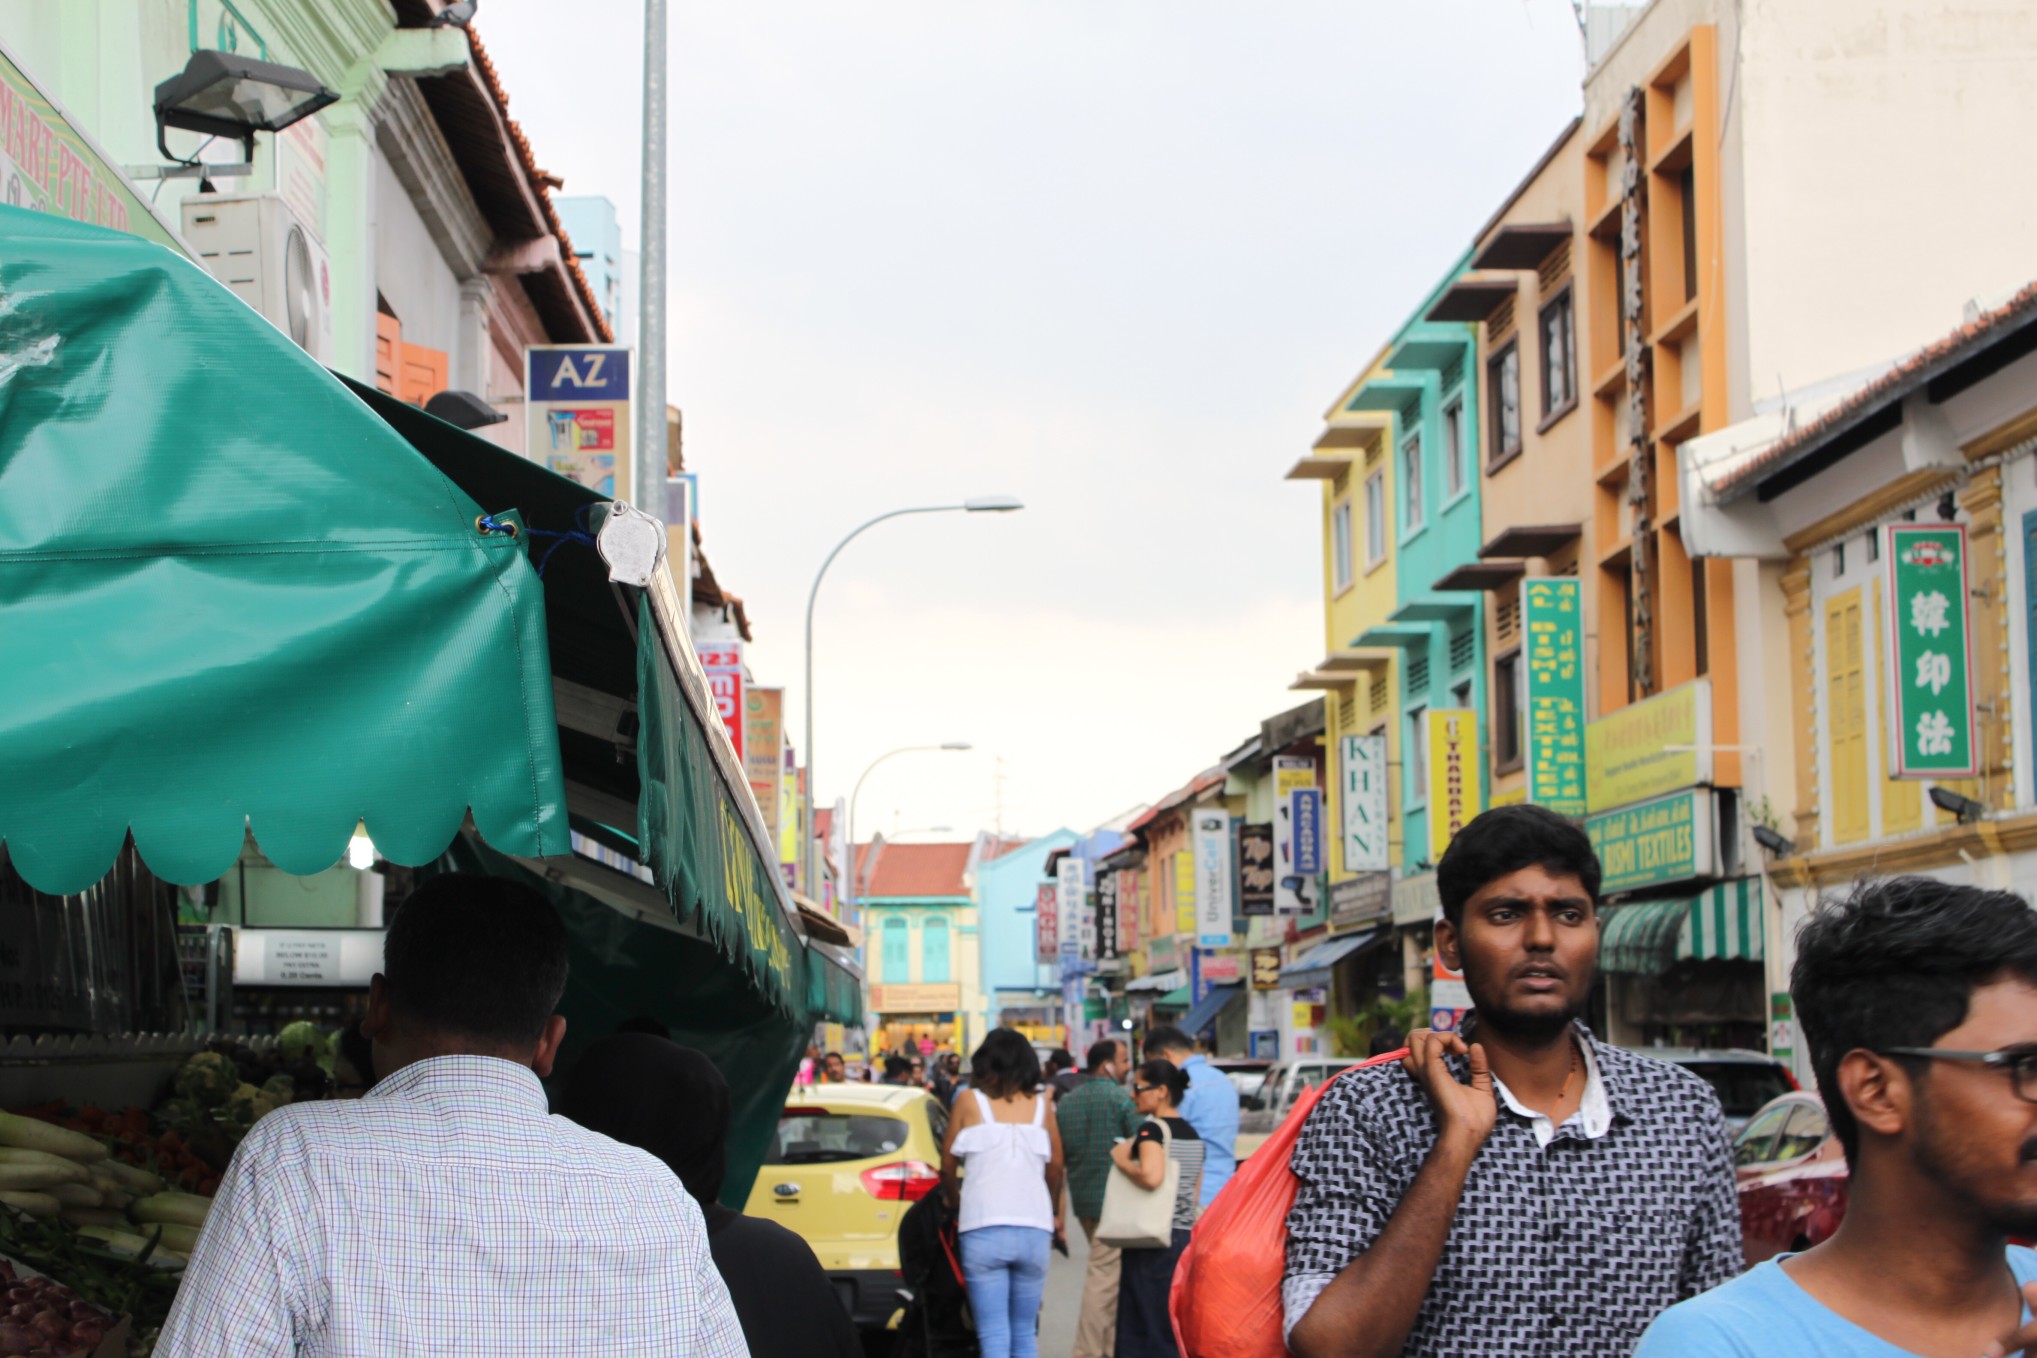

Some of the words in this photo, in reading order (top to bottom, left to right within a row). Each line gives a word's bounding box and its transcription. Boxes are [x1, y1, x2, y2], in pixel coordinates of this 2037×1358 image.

[56, 140, 92, 223] PTE
[551, 353, 608, 388] AZ
[1530, 621, 1558, 683] BISMI
[1532, 697, 1563, 797] TEXTILES
[1349, 738, 1370, 853] KHAN
[1604, 838, 1636, 878] BISMI
[1636, 823, 1693, 871] TEXTILES
